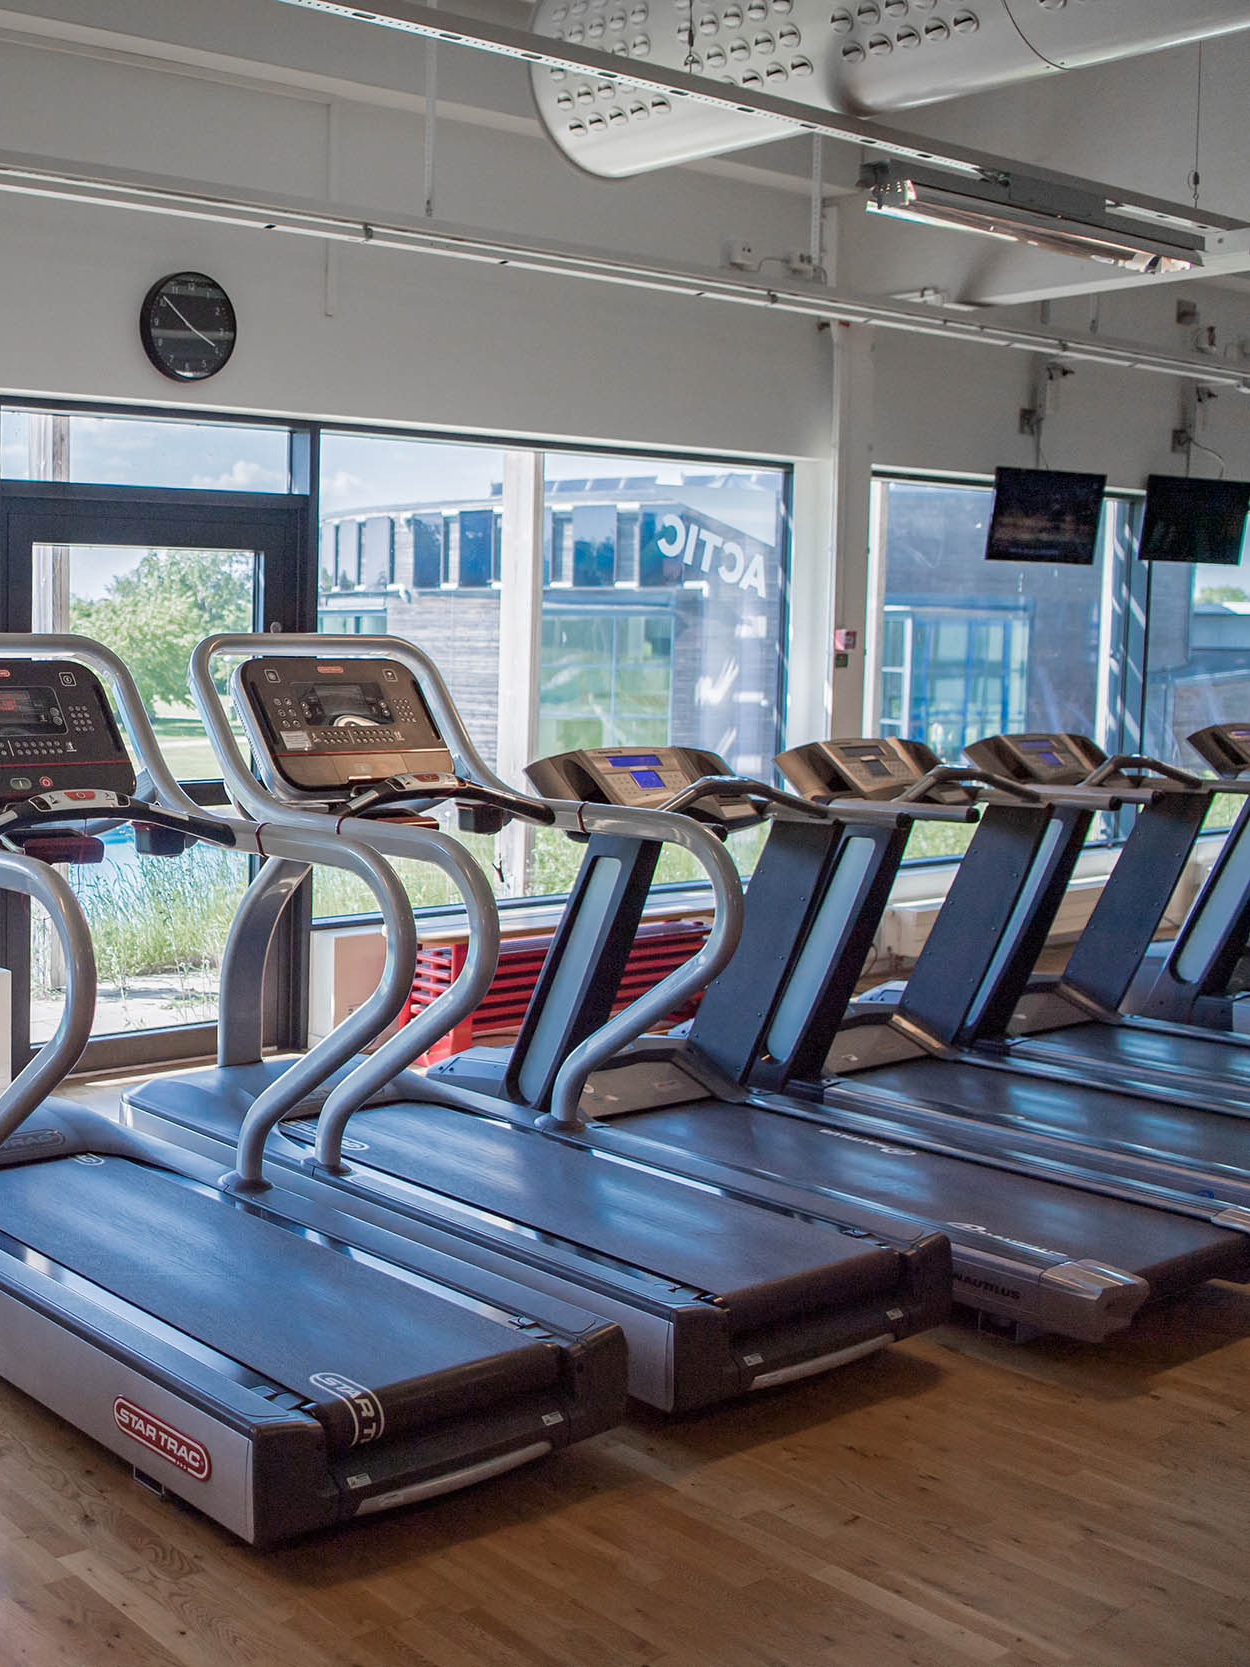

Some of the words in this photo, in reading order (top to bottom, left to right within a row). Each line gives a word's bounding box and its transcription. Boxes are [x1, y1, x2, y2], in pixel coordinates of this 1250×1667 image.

[317, 1375, 375, 1417] STAR
[117, 1408, 157, 1441] STAR
[158, 1431, 201, 1467] TRAC
